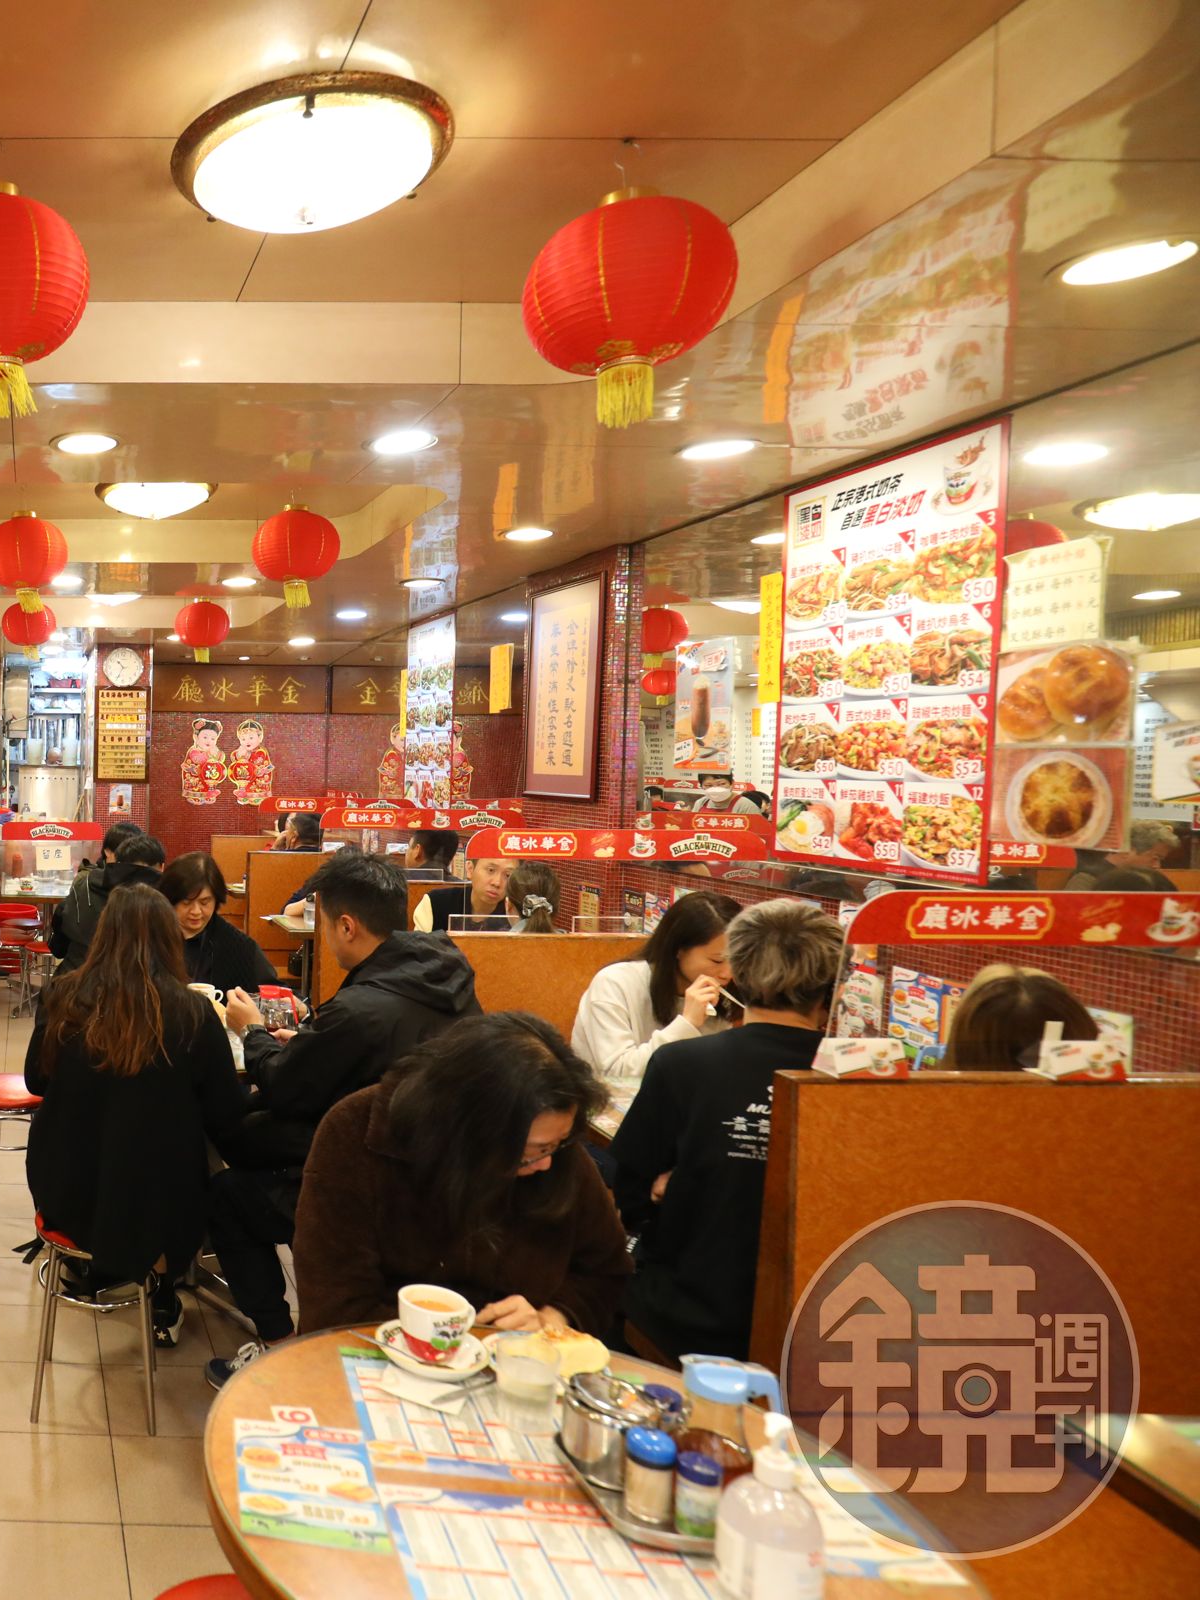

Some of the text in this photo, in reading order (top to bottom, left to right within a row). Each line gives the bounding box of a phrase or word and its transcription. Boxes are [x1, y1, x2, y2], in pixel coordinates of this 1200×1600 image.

[831, 473, 904, 512] 正宗港式奶茶
[841, 490, 926, 531] 首選黑白淡奶
[987, 511, 996, 525] 3
[907, 531, 915, 544] 2
[839, 549, 845, 561] 1
[964, 579, 995, 600] $50
[823, 605, 846, 622] $50
[982, 603, 992, 618] 6
[902, 615, 910, 628] 5
[834, 626, 843, 639] 4
[884, 677, 909, 694] $50
[959, 672, 984, 687] $54
[172, 674, 307, 706] 金華冰廳
[818, 683, 842, 697] $50
[898, 700, 906, 713] 8
[977, 695, 987, 710] 9
[832, 704, 839, 717] 7
[846, 709, 891, 722] 西式炒通粉
[815, 761, 835, 773] $50
[880, 762, 904, 776] $50
[955, 761, 979, 776] $52
[828, 782, 836, 794] 10
[895, 783, 903, 796] 11
[972, 787, 983, 800] 12
[279, 800, 315, 809] 金華冰廳
[908, 791, 950, 805] 福建炒飯
[346, 812, 395, 823] 金華冰廳
[461, 817, 503, 827] BLACK&WHITE
[32, 827, 70, 837] BLACK&WHITE
[504, 836, 573, 851] 金華冰廳
[672, 841, 735, 857] BLACK&WHITE
[812, 838, 830, 849] $42
[875, 843, 898, 858] $56
[950, 852, 975, 868] $57
[918, 904, 1046, 931] 金華冰廳
